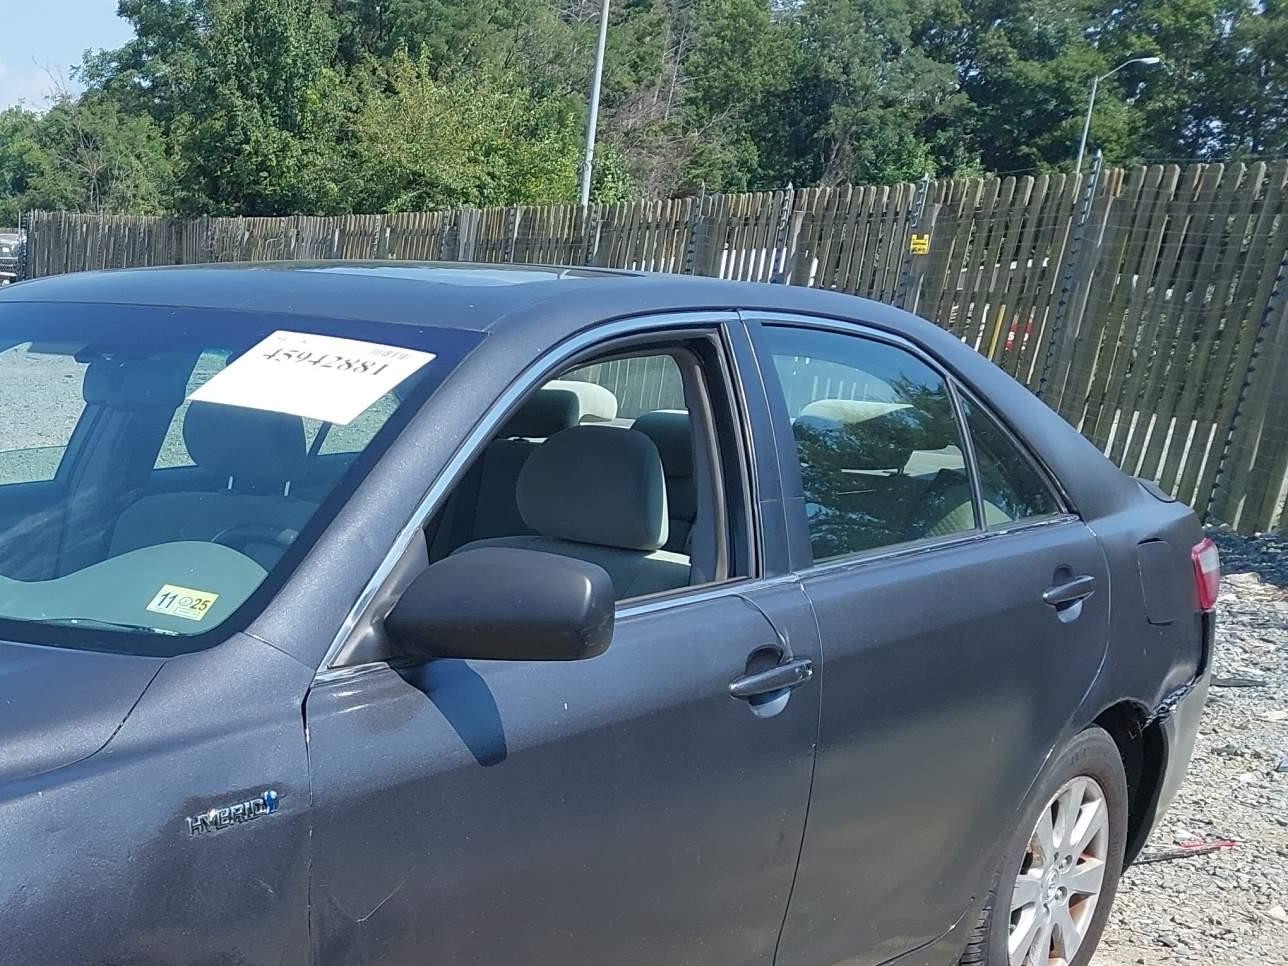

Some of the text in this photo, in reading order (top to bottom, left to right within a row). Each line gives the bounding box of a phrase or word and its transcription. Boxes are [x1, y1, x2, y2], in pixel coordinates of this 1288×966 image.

[263, 348, 390, 376] 45942881
[157, 592, 211, 611] 11 25
[185, 797, 269, 837] HYBRID
